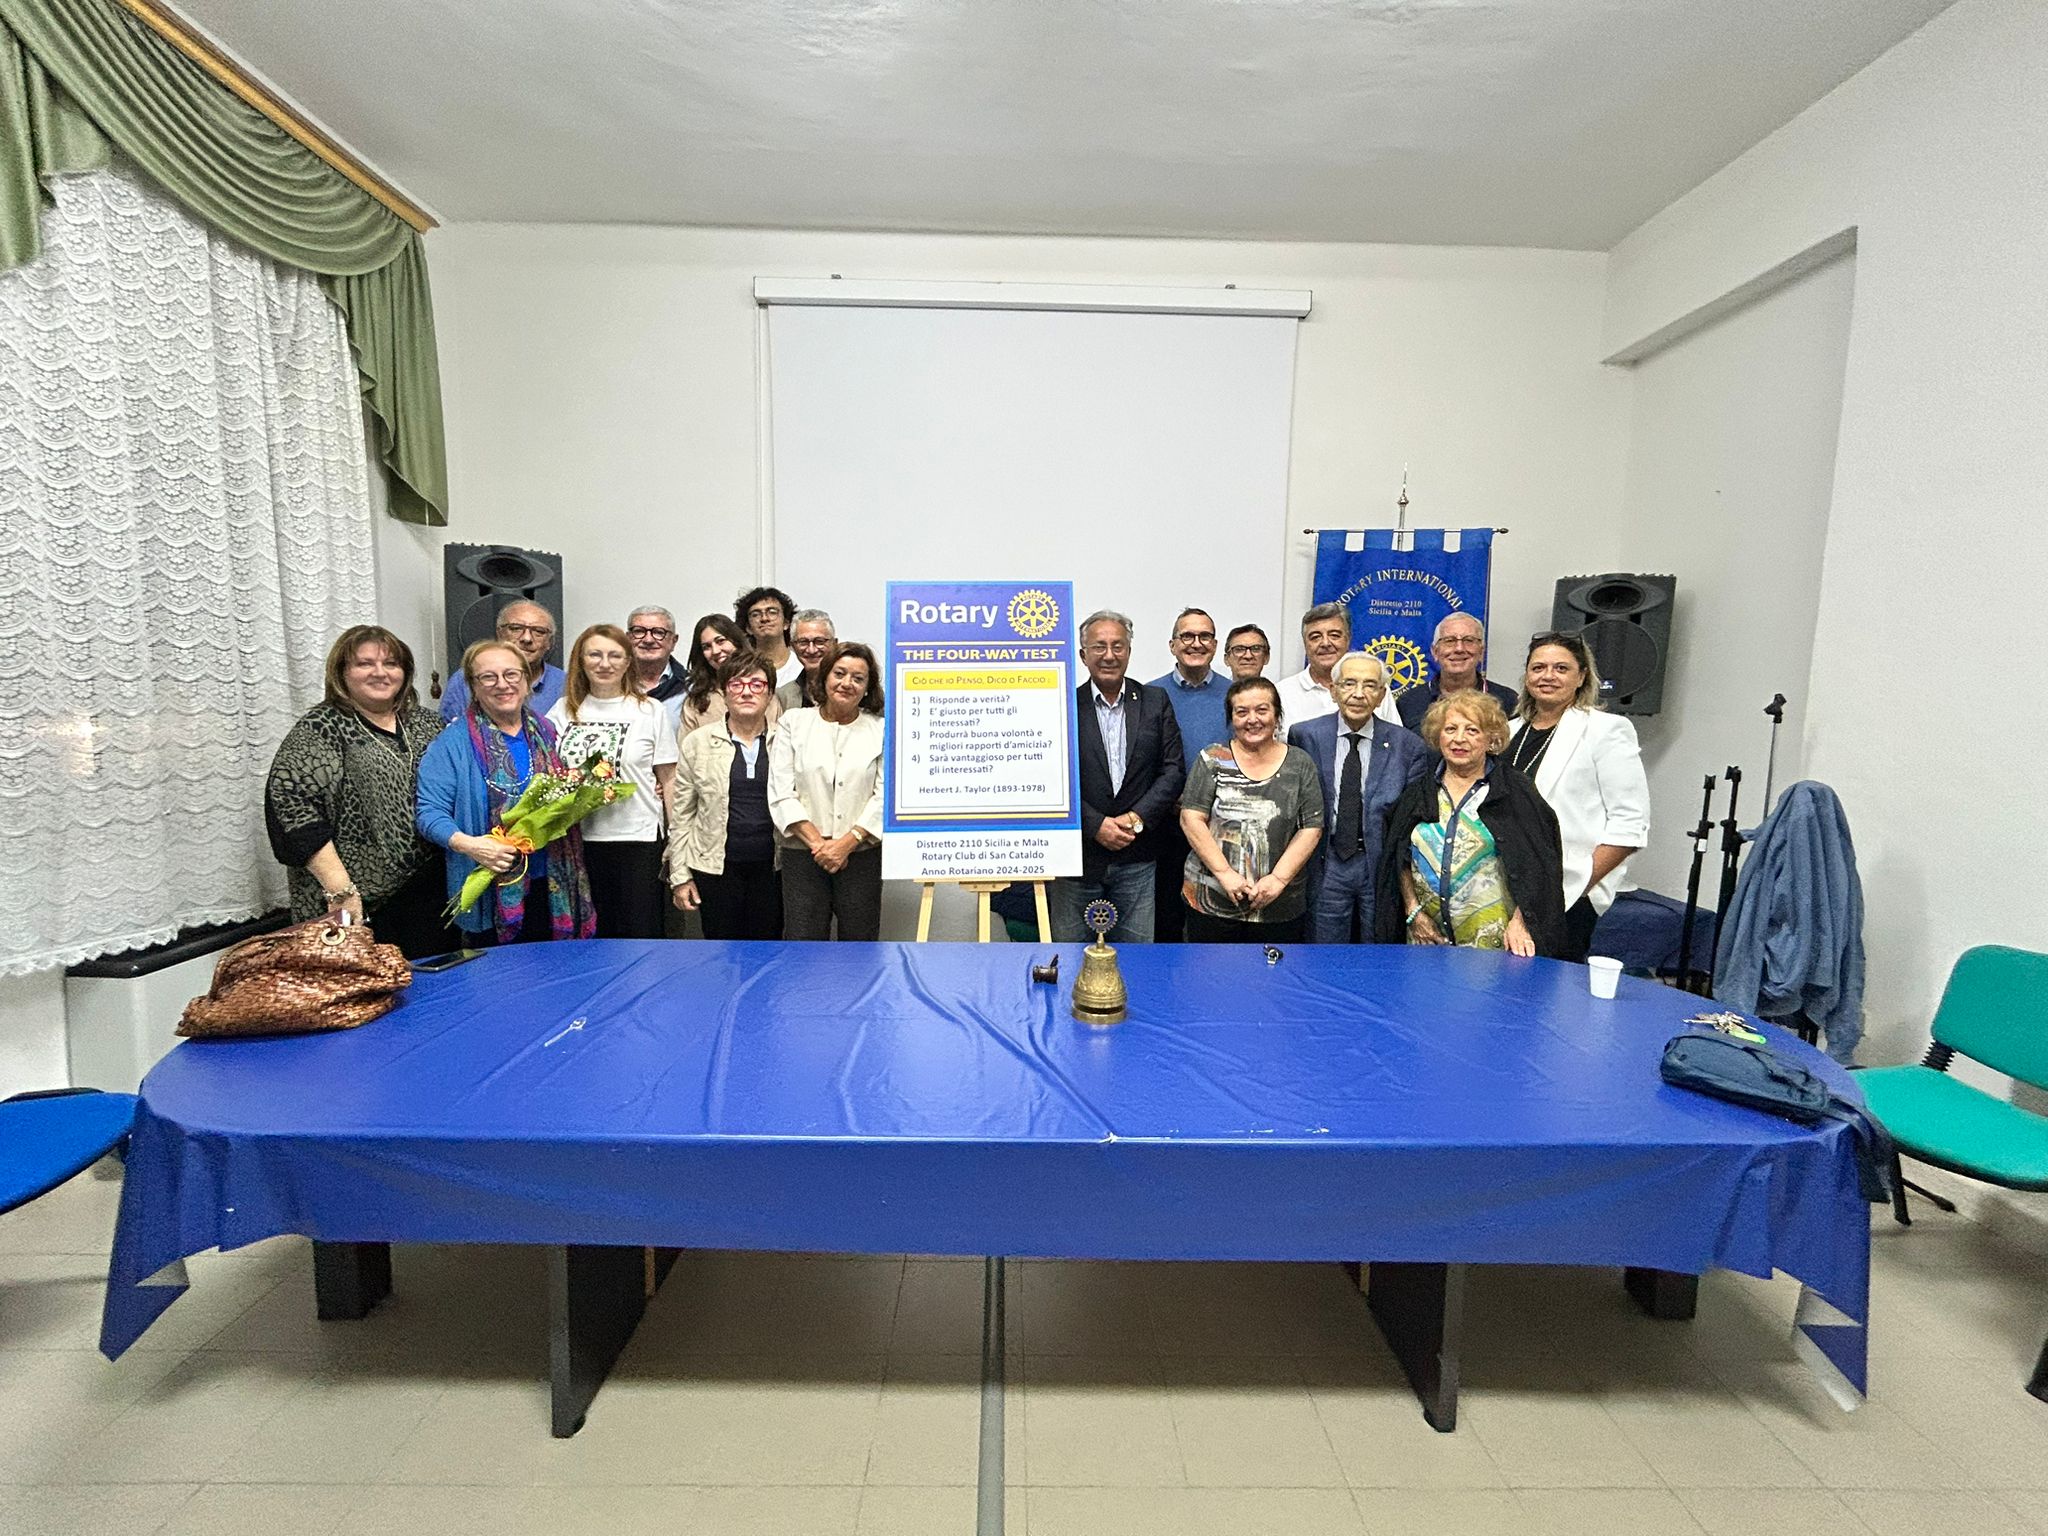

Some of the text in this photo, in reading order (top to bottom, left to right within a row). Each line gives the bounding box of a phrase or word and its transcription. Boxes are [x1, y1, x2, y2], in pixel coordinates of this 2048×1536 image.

[1335, 569, 1464, 610] ROTARY INTERNATIONAL
[901, 600, 998, 628] Rotary
[1369, 607, 1392, 615] Sicilia
[904, 649, 1058, 660] THE FOUR-WAY TEST
[930, 696, 970, 705] Risponde
[980, 695, 1010, 703] verità?
[912, 708, 920, 716] 2)
[940, 708, 966, 717] giusto
[969, 709, 984, 717] per
[1007, 707, 1017, 716] gli
[930, 719, 980, 727] interessati?
[930, 730, 968, 738] Produrrà
[971, 730, 999, 738] buona
[1002, 729, 1035, 737] volontà
[930, 740, 1052, 751] migliori rapporti d'amicizia?
[912, 755, 920, 763] 4)
[930, 754, 948, 762] Sarà
[951, 754, 1004, 763] vantaggioso
[930, 765, 993, 775] gli interessati?
[965, 785, 990, 794] Taylor
[993, 785, 1045, 793] (1893-1978)
[917, 840, 957, 848] Distretto
[985, 839, 1011, 847] Sicilia
[1023, 839, 1049, 847] Malta
[922, 853, 952, 862] Rotary
[955, 852, 975, 860] Club
[922, 868, 945, 876] Anno
[949, 867, 993, 875] Rotariano
